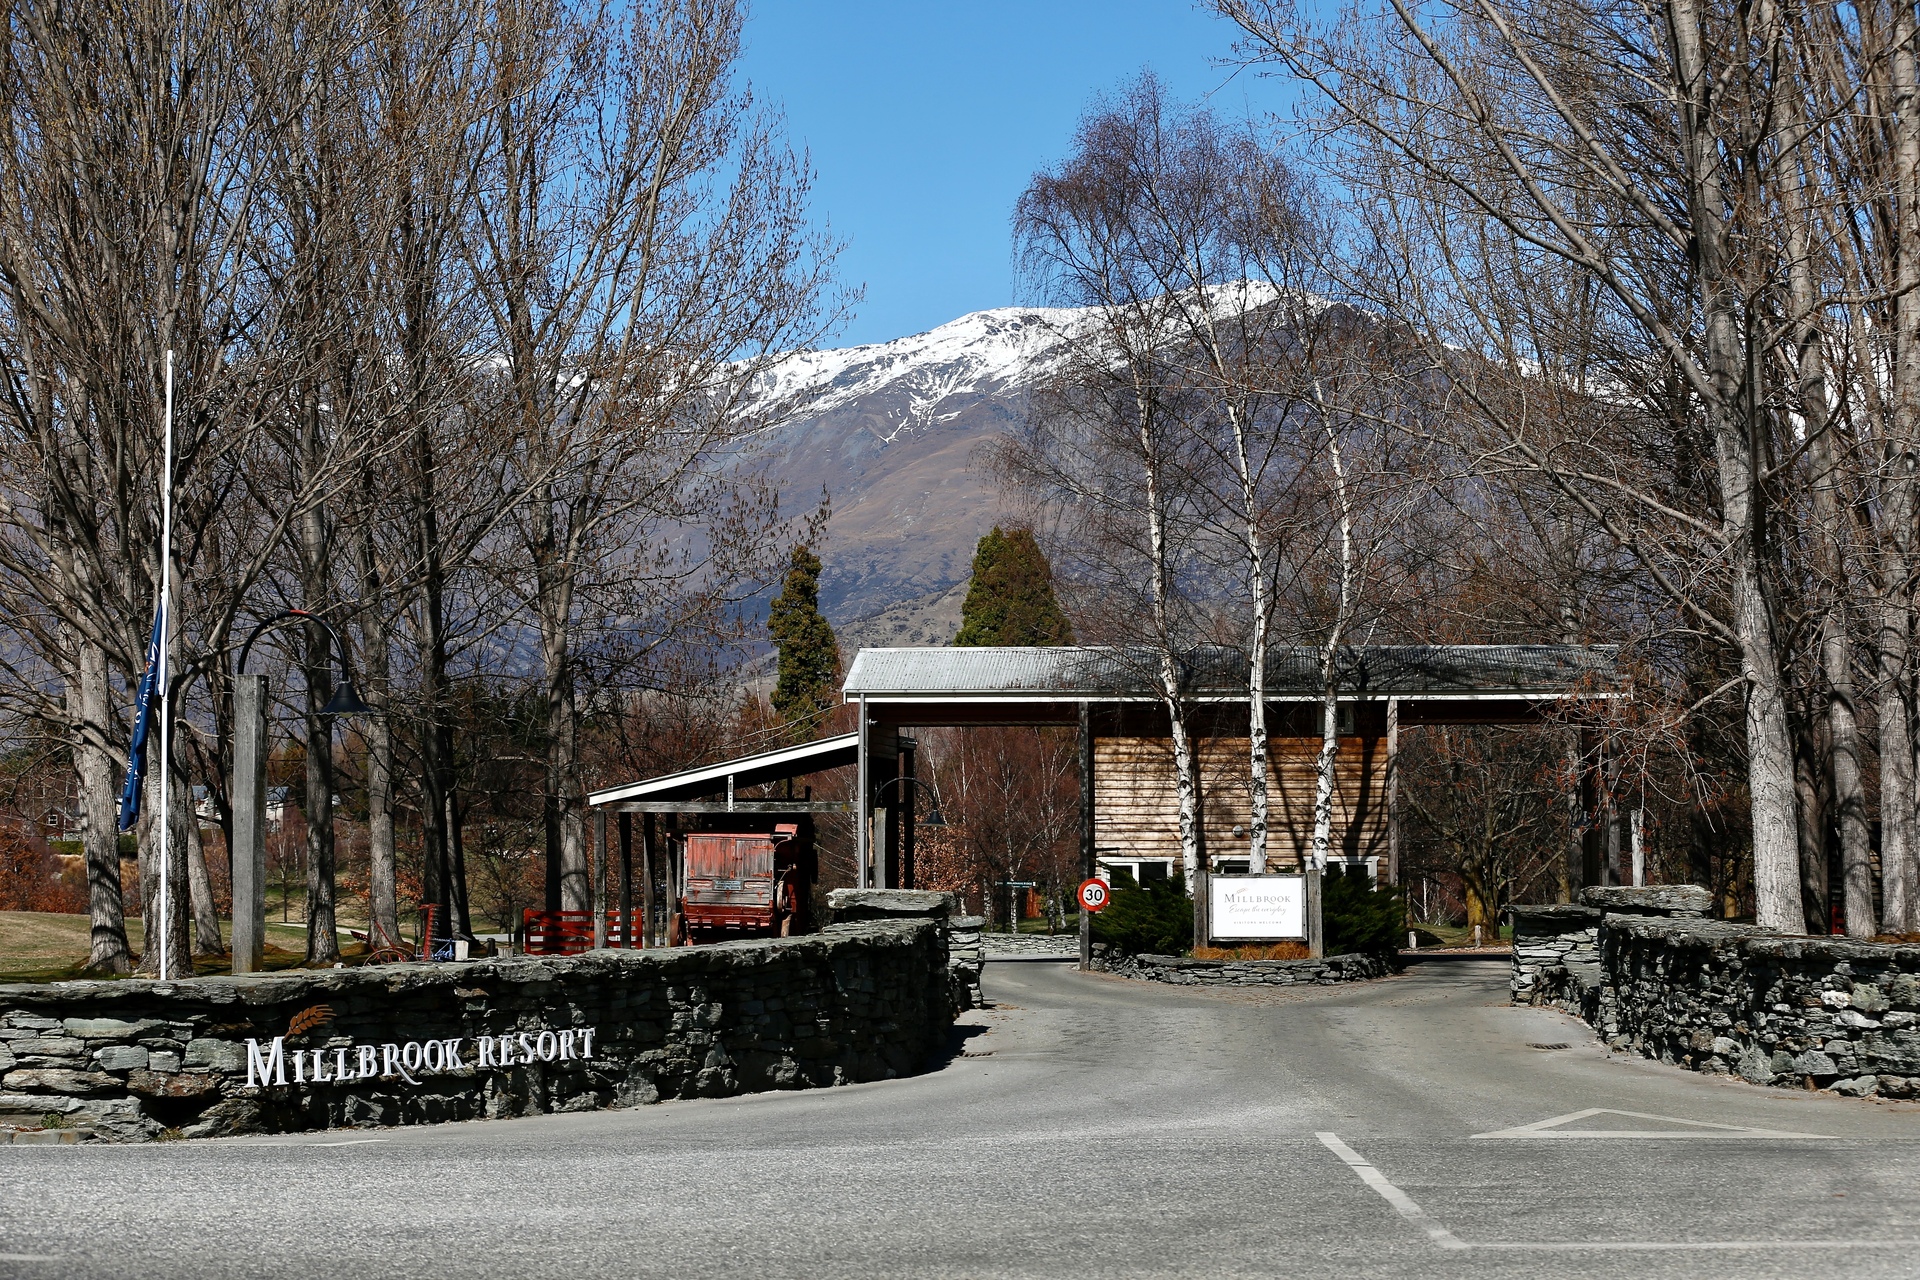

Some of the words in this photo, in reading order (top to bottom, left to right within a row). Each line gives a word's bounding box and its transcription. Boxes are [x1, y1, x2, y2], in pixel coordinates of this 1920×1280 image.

[1085, 889, 1102, 901] 30
[1224, 894, 1291, 904] MILLBROOK
[244, 1036, 466, 1088] MILLBROOK
[475, 1027, 596, 1067] RESORT
